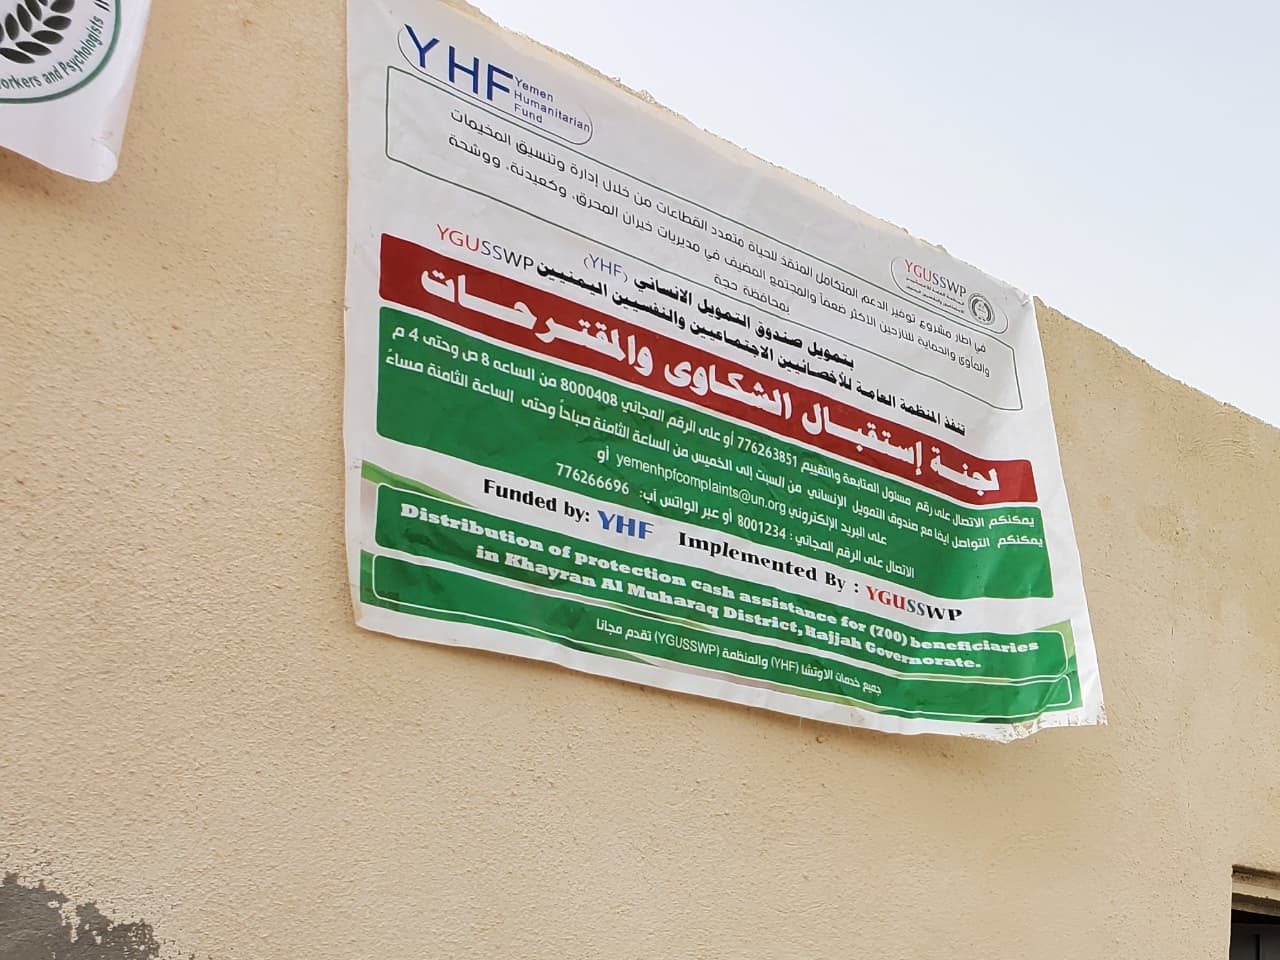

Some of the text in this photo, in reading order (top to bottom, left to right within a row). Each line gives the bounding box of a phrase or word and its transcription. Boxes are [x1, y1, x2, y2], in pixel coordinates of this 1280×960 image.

[0, 15, 104, 90] orkers and Psychologists
[404, 23, 514, 101] YHF
[515, 76, 554, 103] Yemen
[514, 90, 591, 133] Humanitarian
[514, 103, 543, 124] Fund
[450, 108, 512, 146] المخيمات
[448, 133, 501, 169] ووشحة
[516, 140, 566, 172] وتنسيق
[570, 162, 599, 188] إدارة
[602, 179, 630, 198] خلال
[633, 191, 652, 208] من
[622, 210, 653, 232] خيران
[656, 201, 708, 232] القطاعات
[436, 224, 534, 270] YGUSSWP
[656, 225, 700, 254] مديريات
[711, 226, 744, 248] متعدد
[704, 248, 720, 263] في
[748, 240, 778, 262] للحياة
[724, 256, 766, 280] المضيف
[780, 255, 813, 278] المنفذ
[536, 261, 608, 297] اليمنيين
[816, 272, 858, 298] المتكامل
[904, 259, 967, 297] YGUSSWP
[714, 274, 790, 316] بمحافظة حجة
[770, 275, 817, 304] والمجتمع
[611, 290, 686, 330] والنفسيين
[697, 298, 751, 330] التمويل
[861, 294, 888, 312] الدعم
[392, 326, 405, 340] م
[408, 327, 419, 342] 4
[754, 320, 803, 349] صندوق
[879, 320, 914, 342] للنازحين
[920, 320, 952, 340] مشروع
[422, 334, 459, 359] وحتى
[462, 350, 478, 362] ص
[807, 342, 854, 372] بتمويل
[480, 352, 490, 367] 8
[420, 269, 1000, 496] لجنة إستقبال الشكاوى والمقترحات
[426, 362, 469, 388] الثامنة
[538, 372, 557, 388] من
[472, 378, 514, 403] الساعة
[560, 377, 618, 407] 8000408
[856, 380, 896, 408] العامة
[520, 397, 556, 420] وحتى
[620, 400, 664, 422] المجاني
[900, 398, 941, 425] المنظمة
[592, 416, 630, 440] الثامنة
[666, 415, 696, 434] الرقم
[698, 426, 721, 441] على
[632, 430, 670, 452] الساعة
[723, 430, 734, 448] أو
[597, 445, 610, 464] أو
[672, 443, 690, 458] من
[690, 451, 733, 472] الخميس
[737, 436, 798, 468] 776263851
[556, 462, 630, 496] 776266696
[736, 464, 753, 482] إلى
[755, 469, 786, 489] السبت
[800, 460, 842, 485] والتقييم
[843, 472, 880, 494] المتابعة
[616, 453, 786, 516] yemenhpfcomplaints@un.org
[787, 479, 802, 494] من
[483, 478, 656, 540] Funded by: YHF
[658, 496, 699, 515] الواتس
[700, 506, 720, 520] عبر
[852, 500, 886, 521] التمويل
[915, 501, 933, 517] رقم
[934, 508, 951, 522] على
[722, 508, 734, 526] أو
[736, 514, 787, 540] 8001234
[887, 512, 919, 532] صندوق
[952, 514, 985, 528] الاتصال
[988, 514, 1035, 529] يمكنكم
[840, 523, 866, 540] البريد
[867, 531, 888, 546] على
[920, 525, 933, 538] مع
[997, 534, 1044, 548] يمكنكم
[794, 532, 834, 554] المجاني
[952, 535, 990, 552] التواصل
[836, 546, 862, 564] الرقم
[864, 554, 884, 569] على
[400, 502, 1040, 654] Distribution of protection cash assistance for (700) beneficiaries
[678, 531, 818, 582] Implemented
[824, 571, 847, 593] By
[865, 585, 963, 622] YGUSSWP
[885, 560, 916, 579] الاتصال
[476, 545, 500, 563] in
[504, 552, 597, 588] Khayran
[600, 577, 624, 592] Al
[628, 582, 720, 620] Muharaq
[864, 641, 982, 668] Governorate.
[624, 628, 652, 642] تقدم
[654, 630, 720, 657] (YGUSSWP)
[722, 648, 768, 670] والمنظمة
[770, 656, 800, 674] (YHF)
[834, 672, 860, 688] خدمات
[862, 682, 882, 696] جميع
